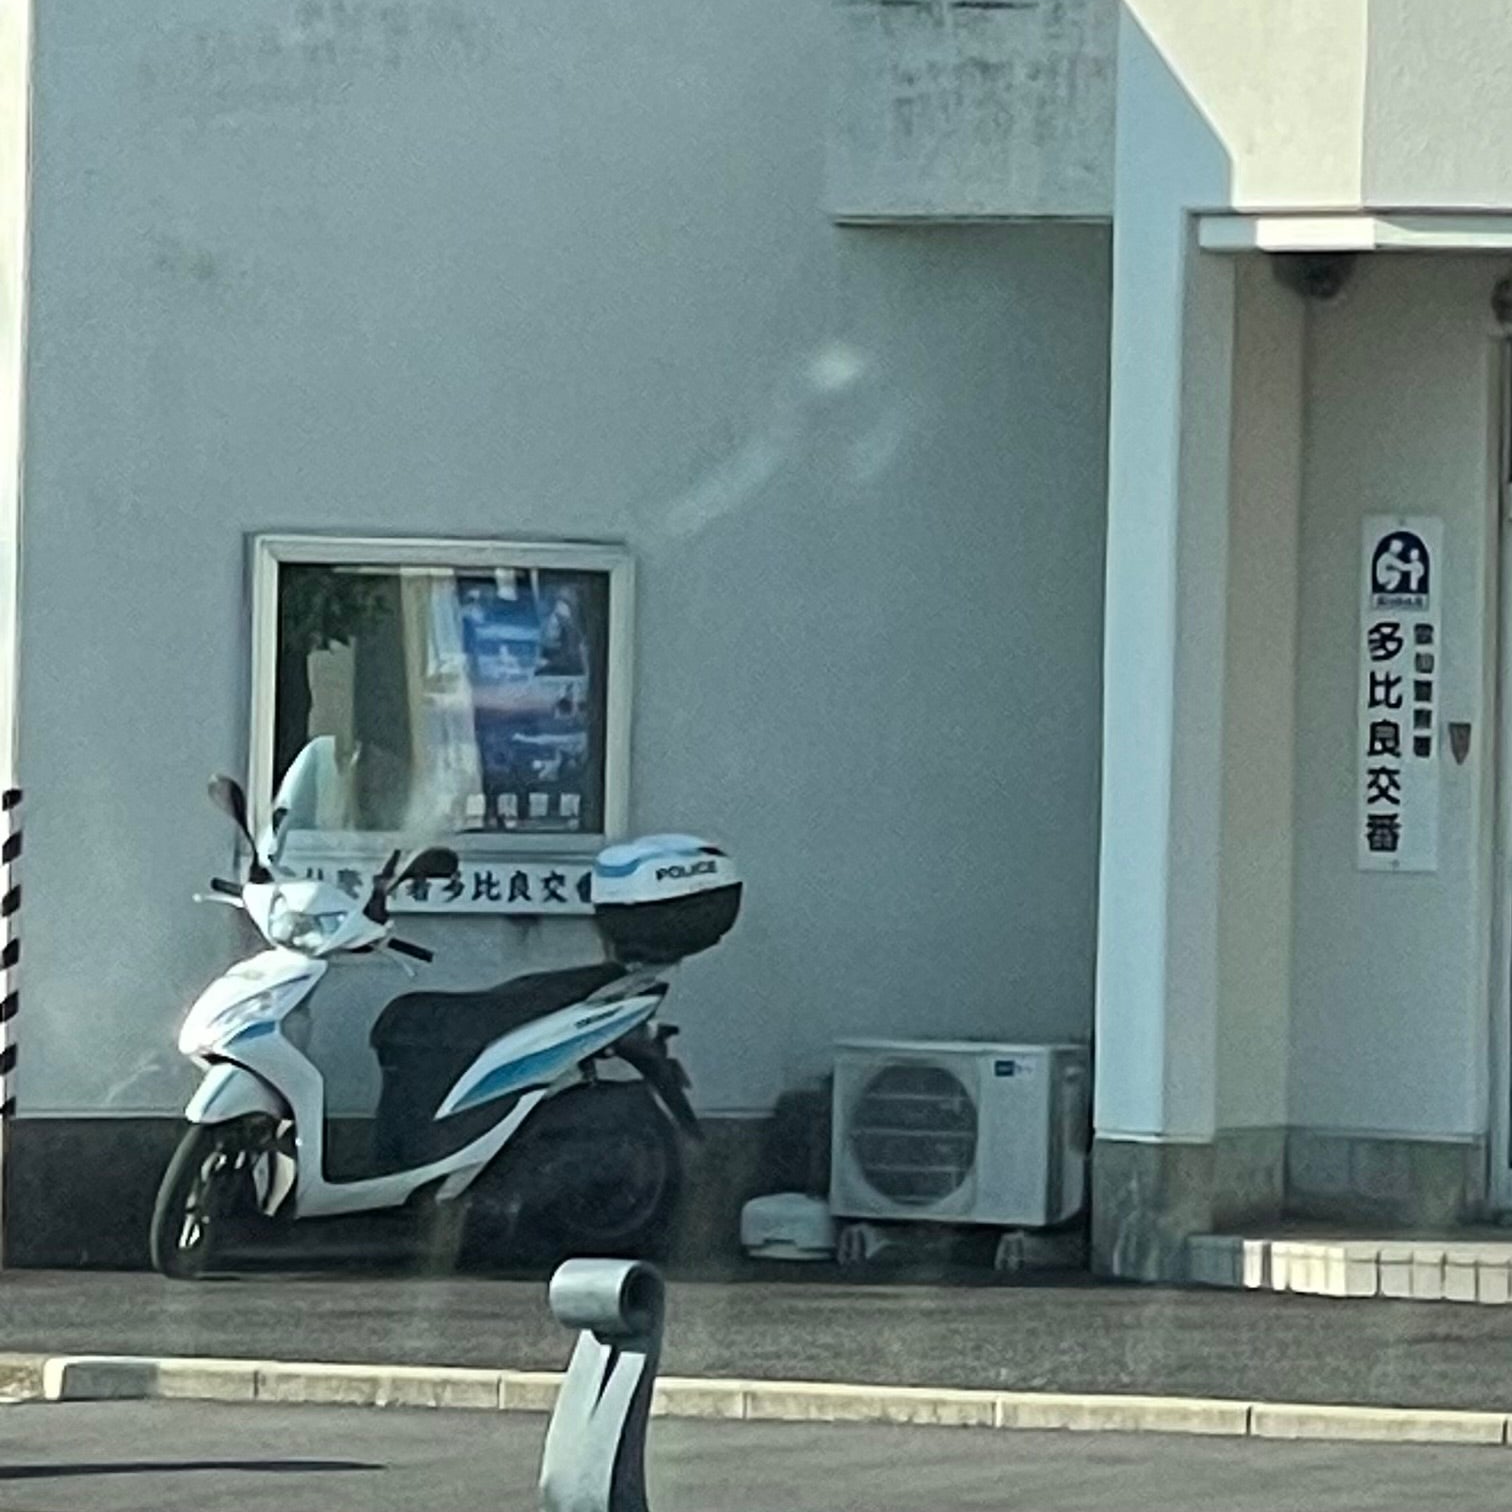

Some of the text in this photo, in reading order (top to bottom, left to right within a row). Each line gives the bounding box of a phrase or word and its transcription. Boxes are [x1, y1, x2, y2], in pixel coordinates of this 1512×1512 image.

[1367, 622, 1403, 852] 多比良交番
[656, 860, 717, 881] POLICE
